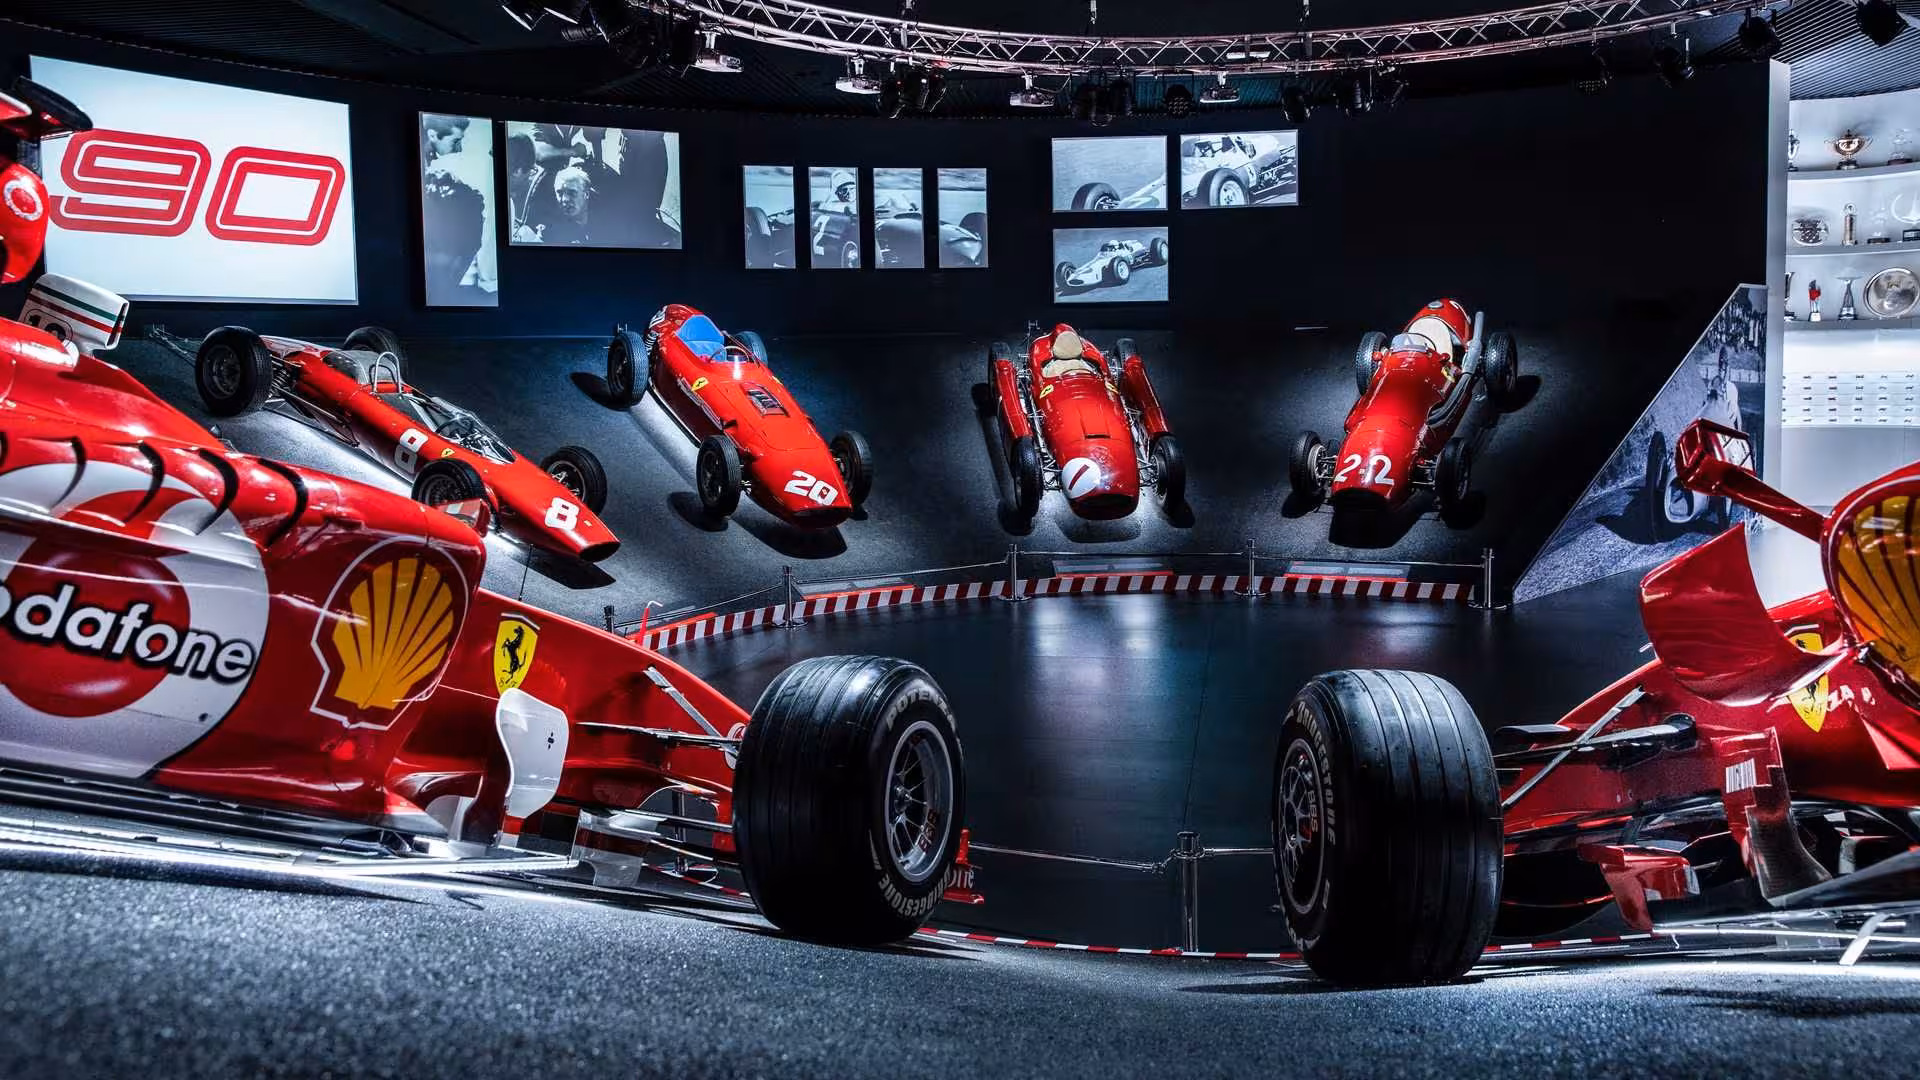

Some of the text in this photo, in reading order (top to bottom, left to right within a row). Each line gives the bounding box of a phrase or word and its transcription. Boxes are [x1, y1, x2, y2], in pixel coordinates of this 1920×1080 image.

[49, 128, 346, 246] 90
[393, 428, 429, 474] 8
[1333, 454, 1395, 485] 22
[784, 470, 839, 506] 20
[544, 496, 581, 531] 8
[1297, 701, 1337, 846] BRIDGESTONE
[878, 862, 952, 917] BRIDGESTONE
